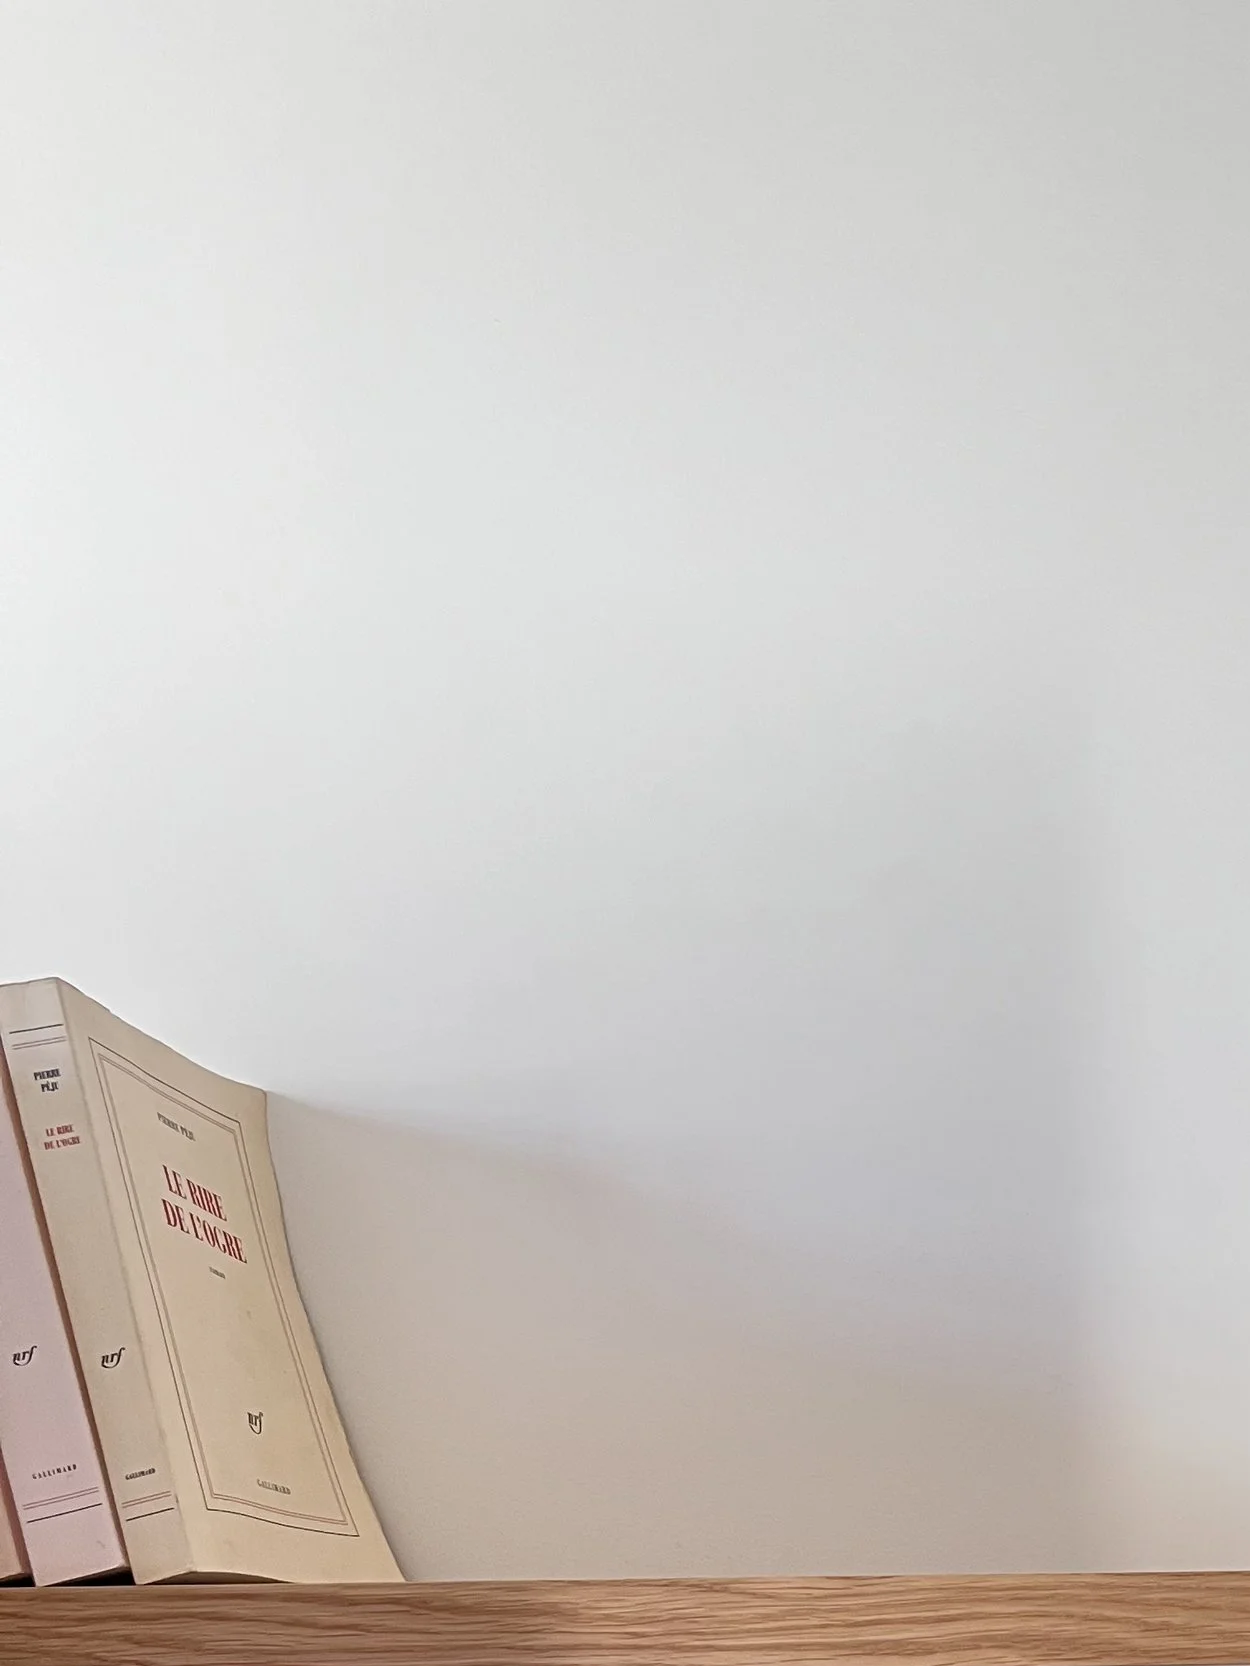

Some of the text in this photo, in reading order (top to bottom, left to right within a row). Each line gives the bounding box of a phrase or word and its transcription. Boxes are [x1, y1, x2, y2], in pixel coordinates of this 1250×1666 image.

[33, 1068, 61, 1081] PIERRE
[45, 1124, 75, 1137] LE RIRE
[43, 1141, 56, 1151] DE
[162, 1164, 228, 1221] LE RIRE
[161, 1199, 191, 1234] DE
[12, 1345, 37, 1366] nrf
[101, 1347, 126, 1369] nrf
[32, 1463, 78, 1480] GALLIMARD
[125, 1468, 156, 1480] GALLIMARD
[256, 1479, 291, 1495] GALLIMARD
